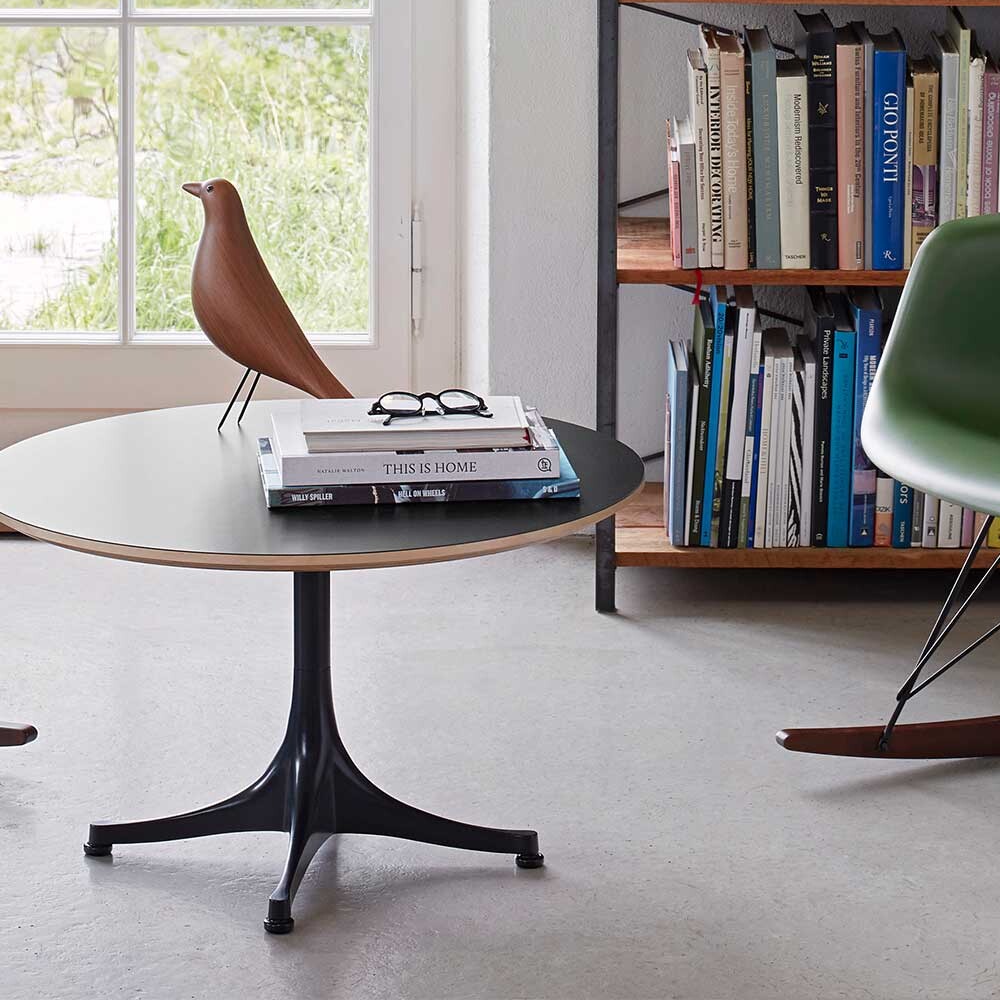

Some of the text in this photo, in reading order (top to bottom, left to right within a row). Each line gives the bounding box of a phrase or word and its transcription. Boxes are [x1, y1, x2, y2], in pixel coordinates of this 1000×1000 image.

[710, 86, 721, 242] INTERIOR DECORATING
[727, 85, 738, 192] Inside Today's Home
[793, 94, 802, 184] Modernism Rediscovered
[884, 93, 898, 182] GIO PONTI
[821, 330, 831, 399] Private Landscapes
[384, 462, 477, 474] THIS IS HOME
